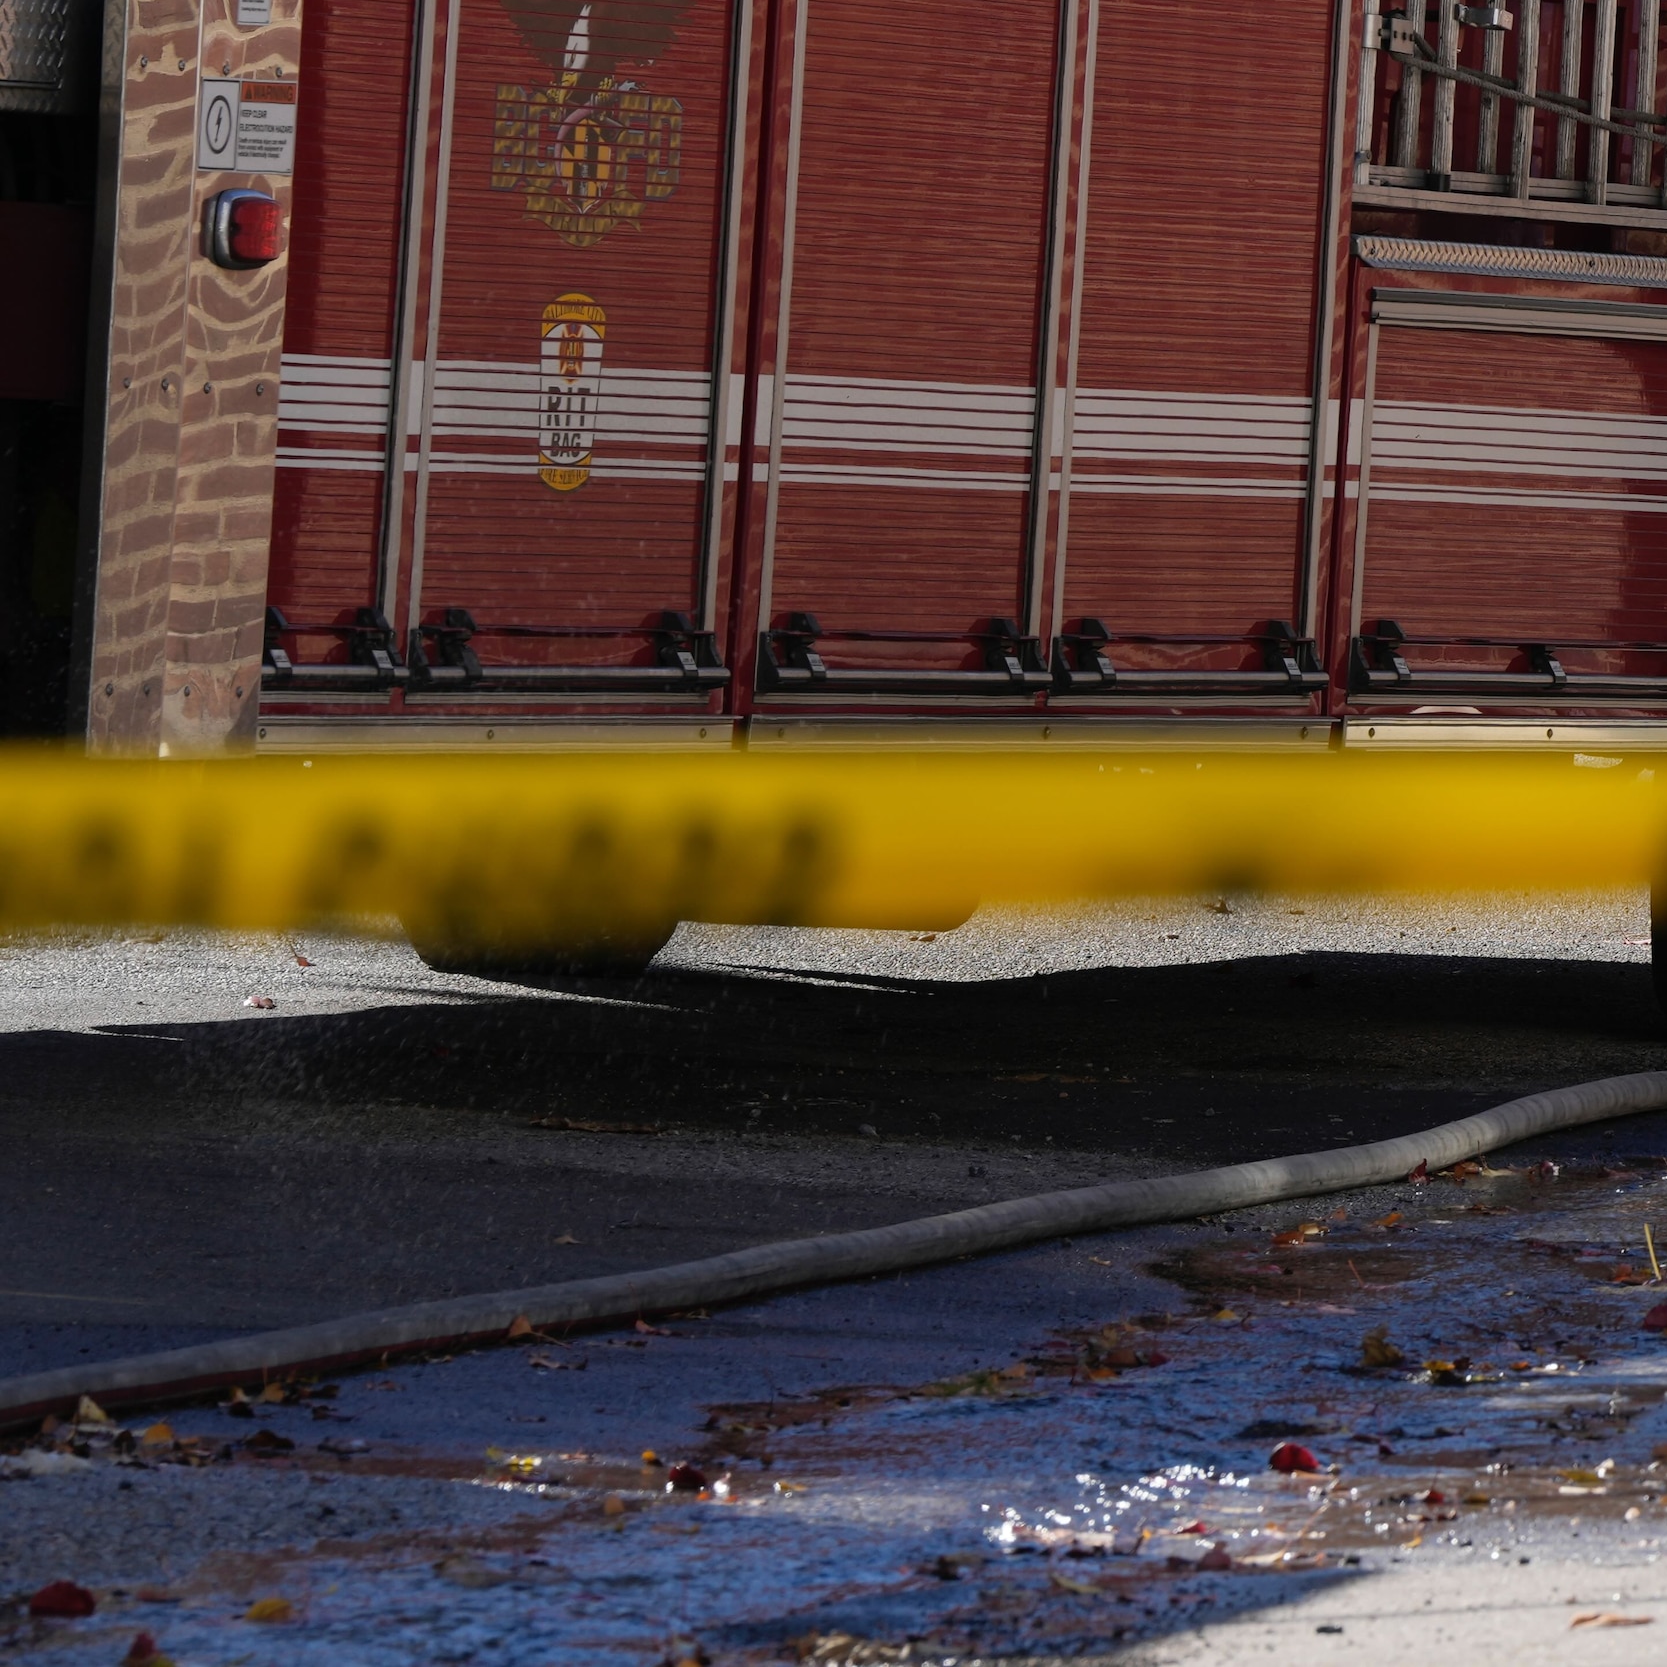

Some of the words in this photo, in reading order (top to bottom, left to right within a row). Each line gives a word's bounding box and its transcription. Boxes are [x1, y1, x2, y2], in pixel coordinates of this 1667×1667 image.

[253, 84, 294, 102] WARNING
[546, 386, 591, 427] RIT
[550, 432, 581, 458] BAG
